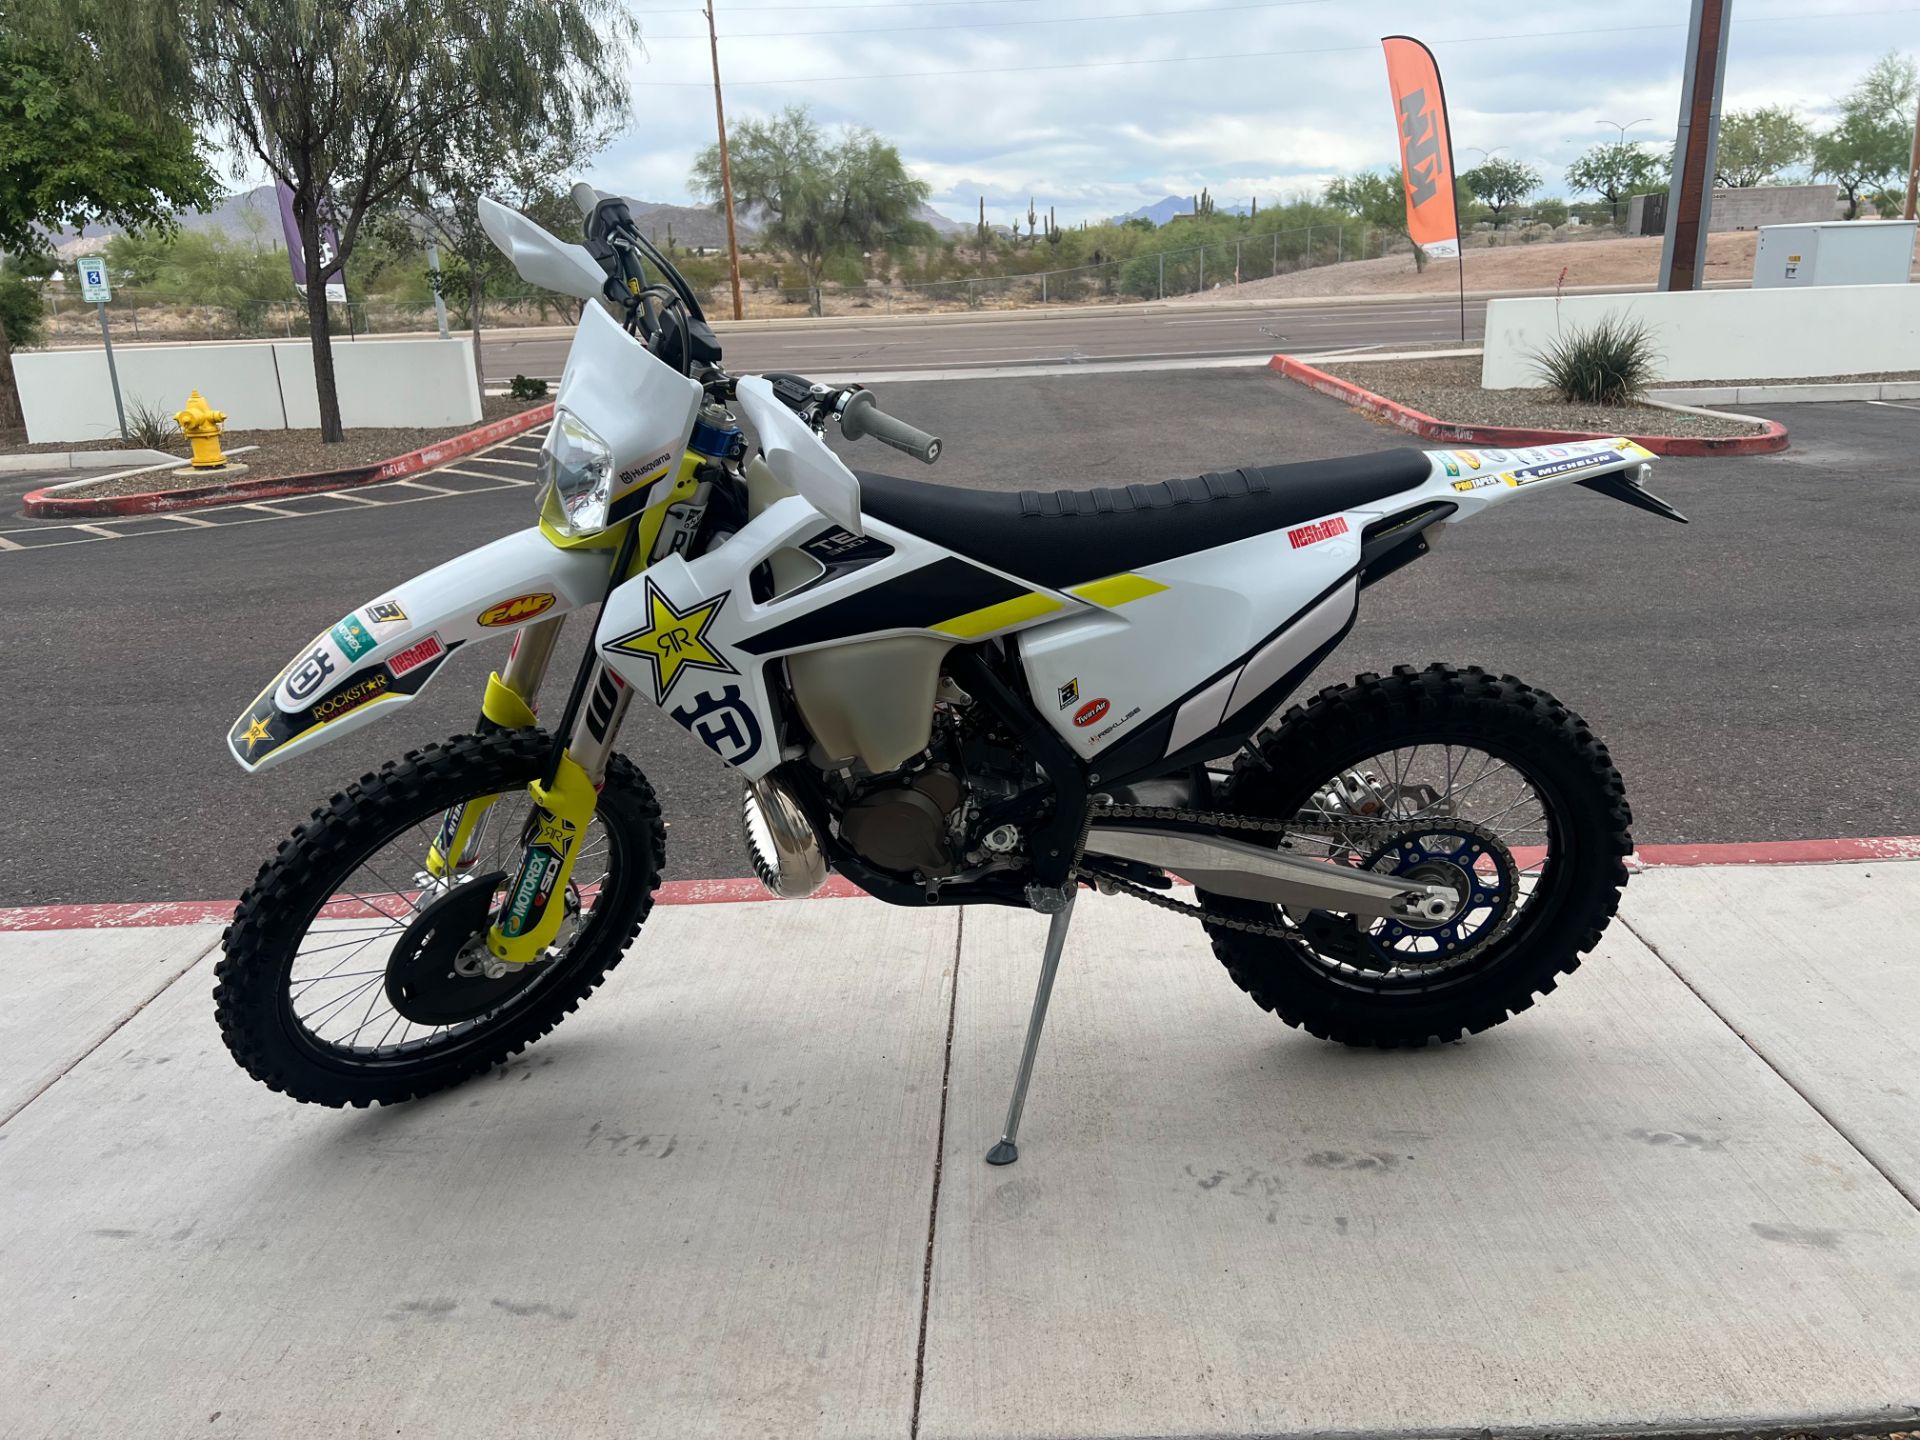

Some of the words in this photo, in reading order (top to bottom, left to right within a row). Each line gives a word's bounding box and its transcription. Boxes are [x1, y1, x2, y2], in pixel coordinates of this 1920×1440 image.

[1400, 88, 1442, 209] KTM
[632, 452, 671, 478] Husqvarna
[1537, 454, 1610, 476] MICHELIN
[482, 593, 555, 625] FMF
[337, 622, 362, 653] MOTOREX
[1076, 709, 1096, 724] Twin
[1095, 701, 1107, 714] Air
[512, 853, 547, 917] MOTOREX
